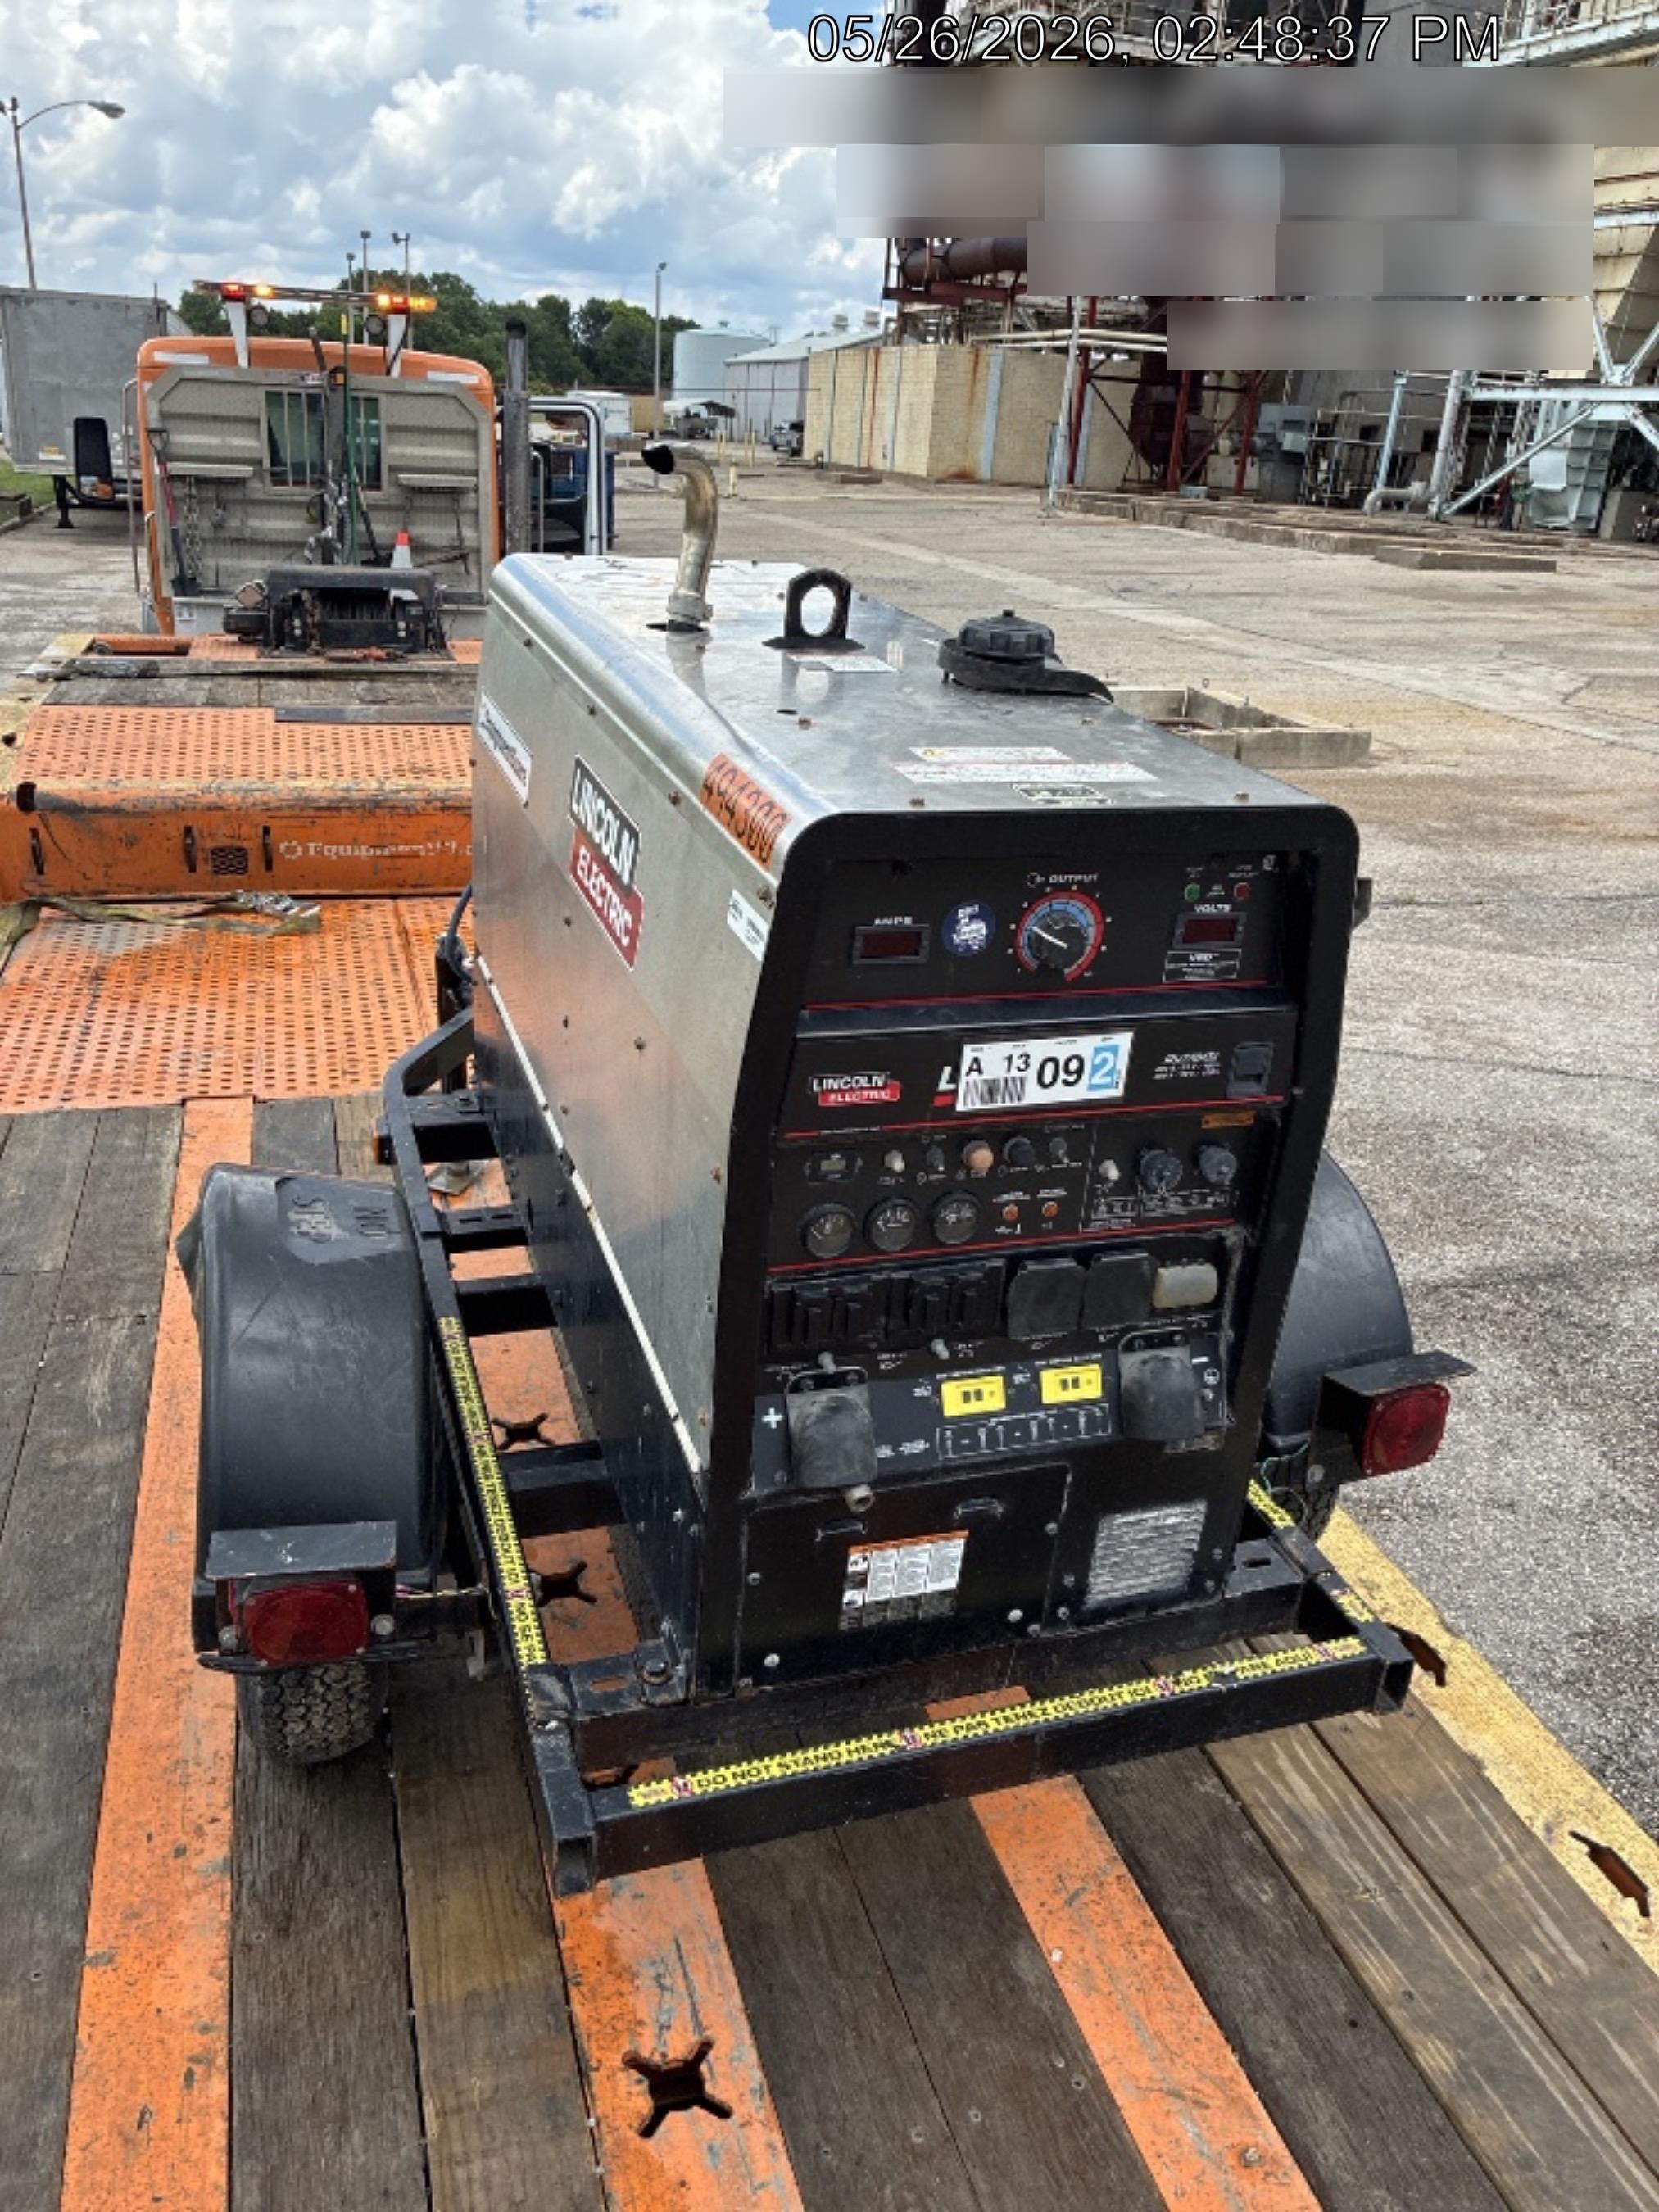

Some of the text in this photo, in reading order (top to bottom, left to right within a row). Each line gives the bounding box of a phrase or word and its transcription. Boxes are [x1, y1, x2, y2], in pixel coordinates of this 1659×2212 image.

[572, 768, 635, 886] LINCOLN
[577, 845, 632, 947] ELECTRIC
[965, 1056, 984, 1077] A
[1003, 1053, 1031, 1074] 13
[813, 1074, 886, 1092] LINCOLN
[828, 1090, 890, 1102] ELECTRIC
[696, 1774, 728, 1788] DO
[731, 1763, 773, 1780] NOT
[777, 1749, 842, 1770] STAND
